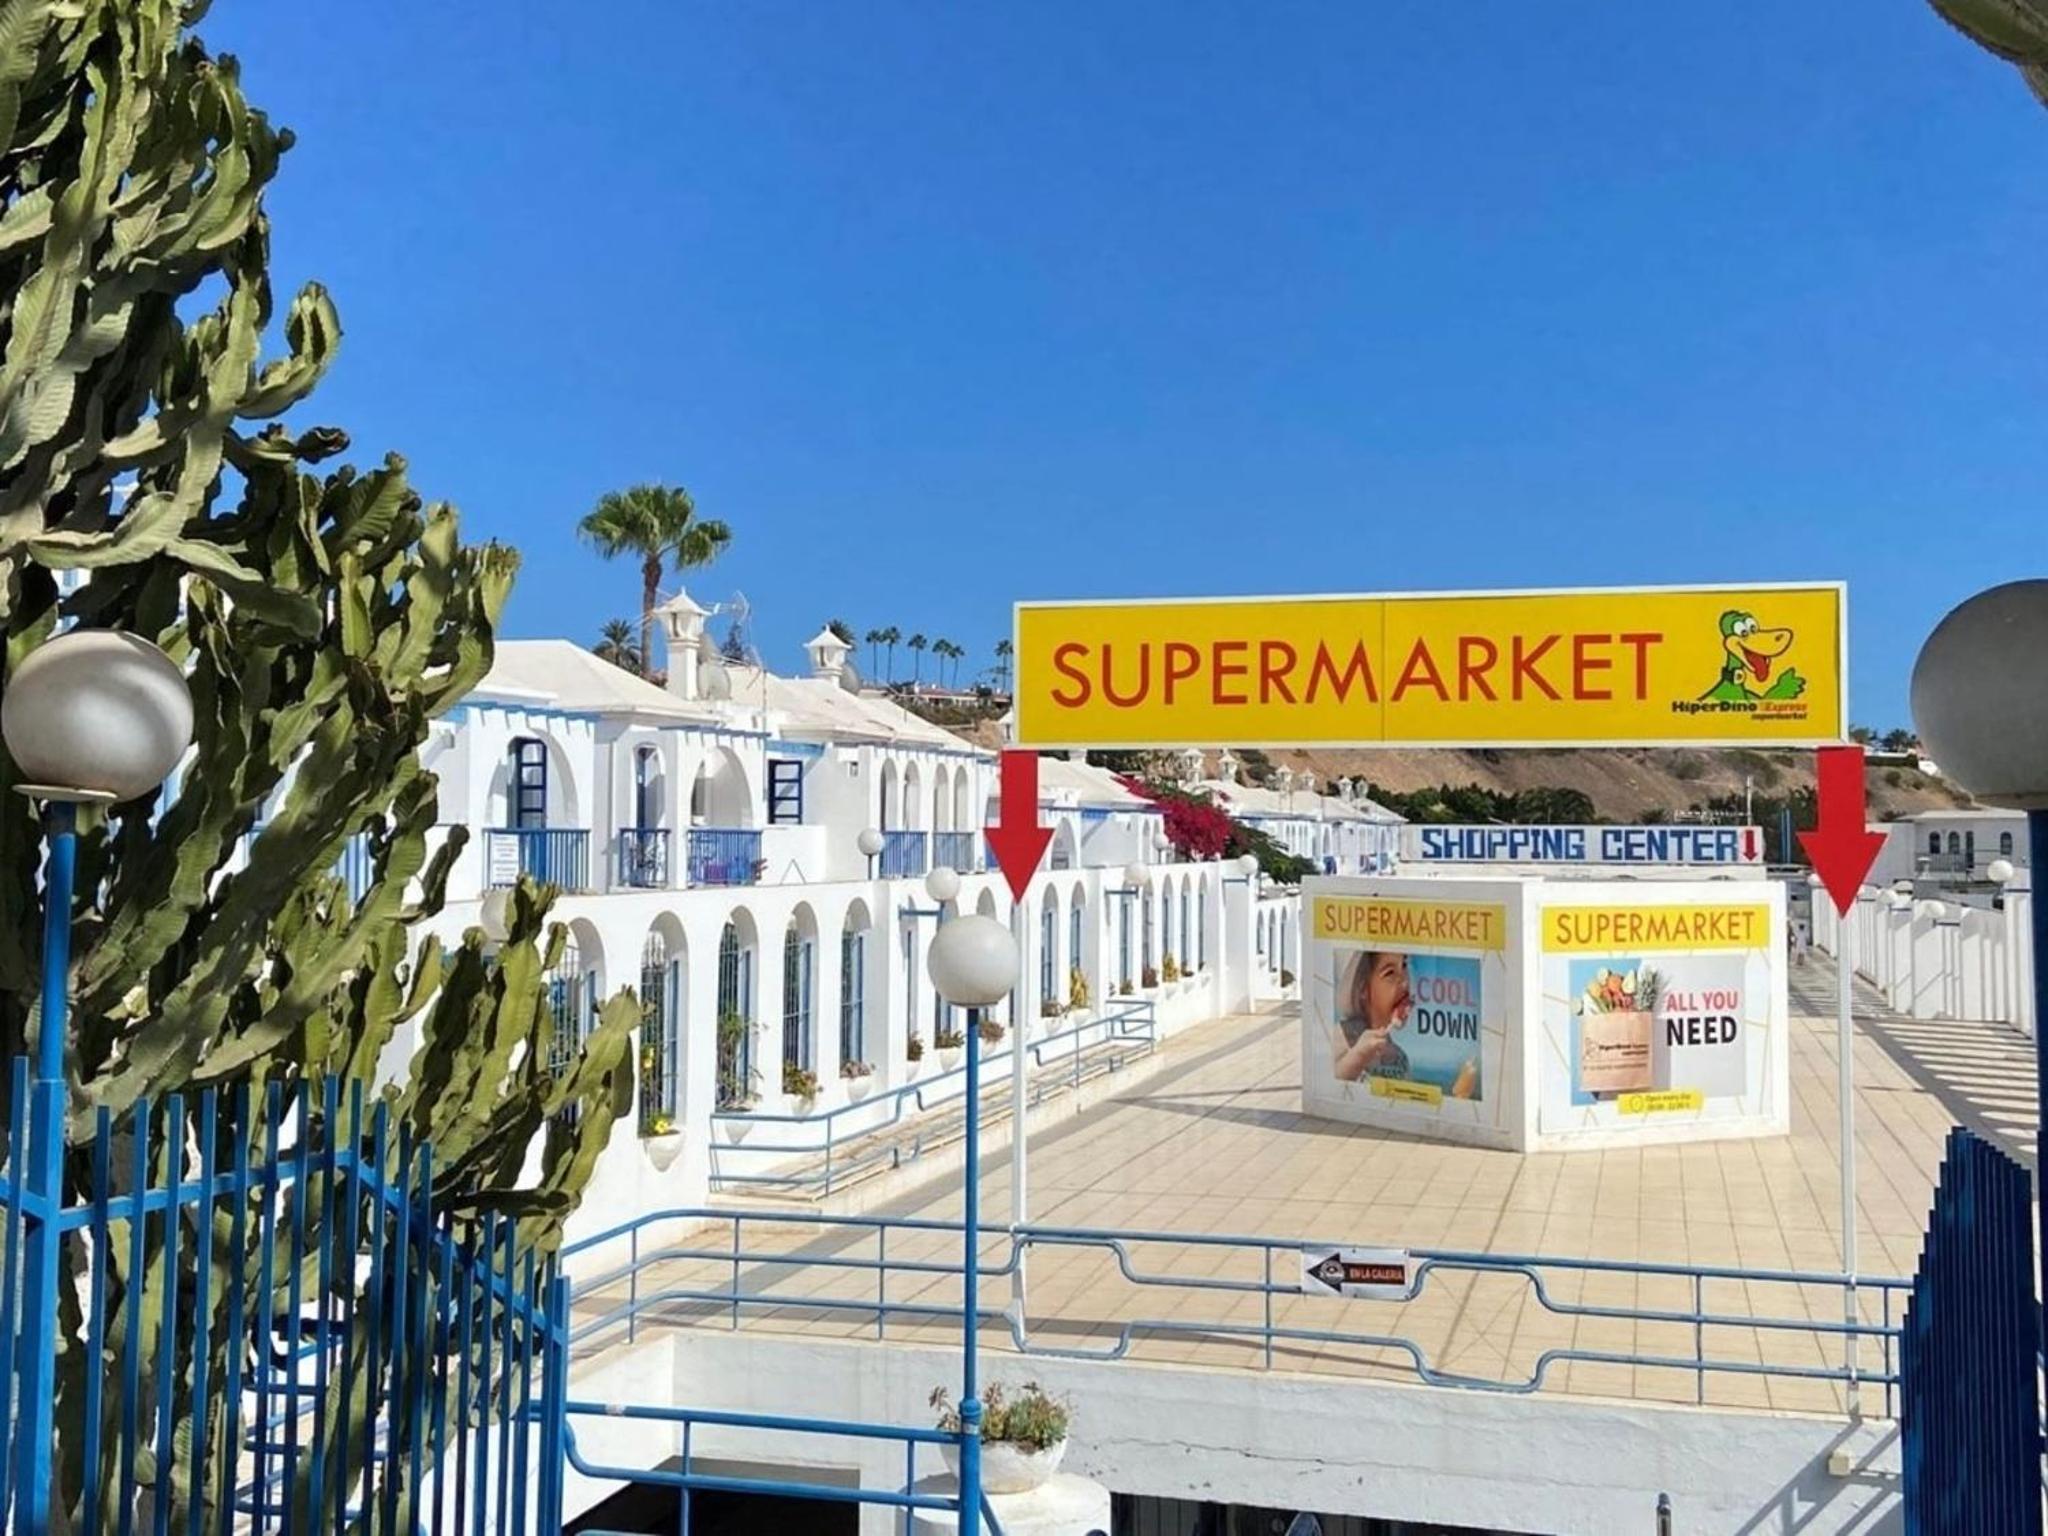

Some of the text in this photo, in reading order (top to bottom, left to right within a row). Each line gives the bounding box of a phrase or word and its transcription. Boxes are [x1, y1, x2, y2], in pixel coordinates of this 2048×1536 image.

[1051, 632, 1664, 708] SUPERMARKET
[1671, 700, 1757, 714] HiperDino
[1421, 829, 1738, 861] SHOPPING CENTER
[1324, 904, 1493, 941] SUPERMARKET
[1556, 911, 1755, 944] SUPERMARKET
[1417, 976, 1477, 1007] COOL
[1666, 991, 1739, 1012] ALL YOU
[1417, 1008, 1478, 1041] DOWN
[1666, 1016, 1737, 1046] NEED
